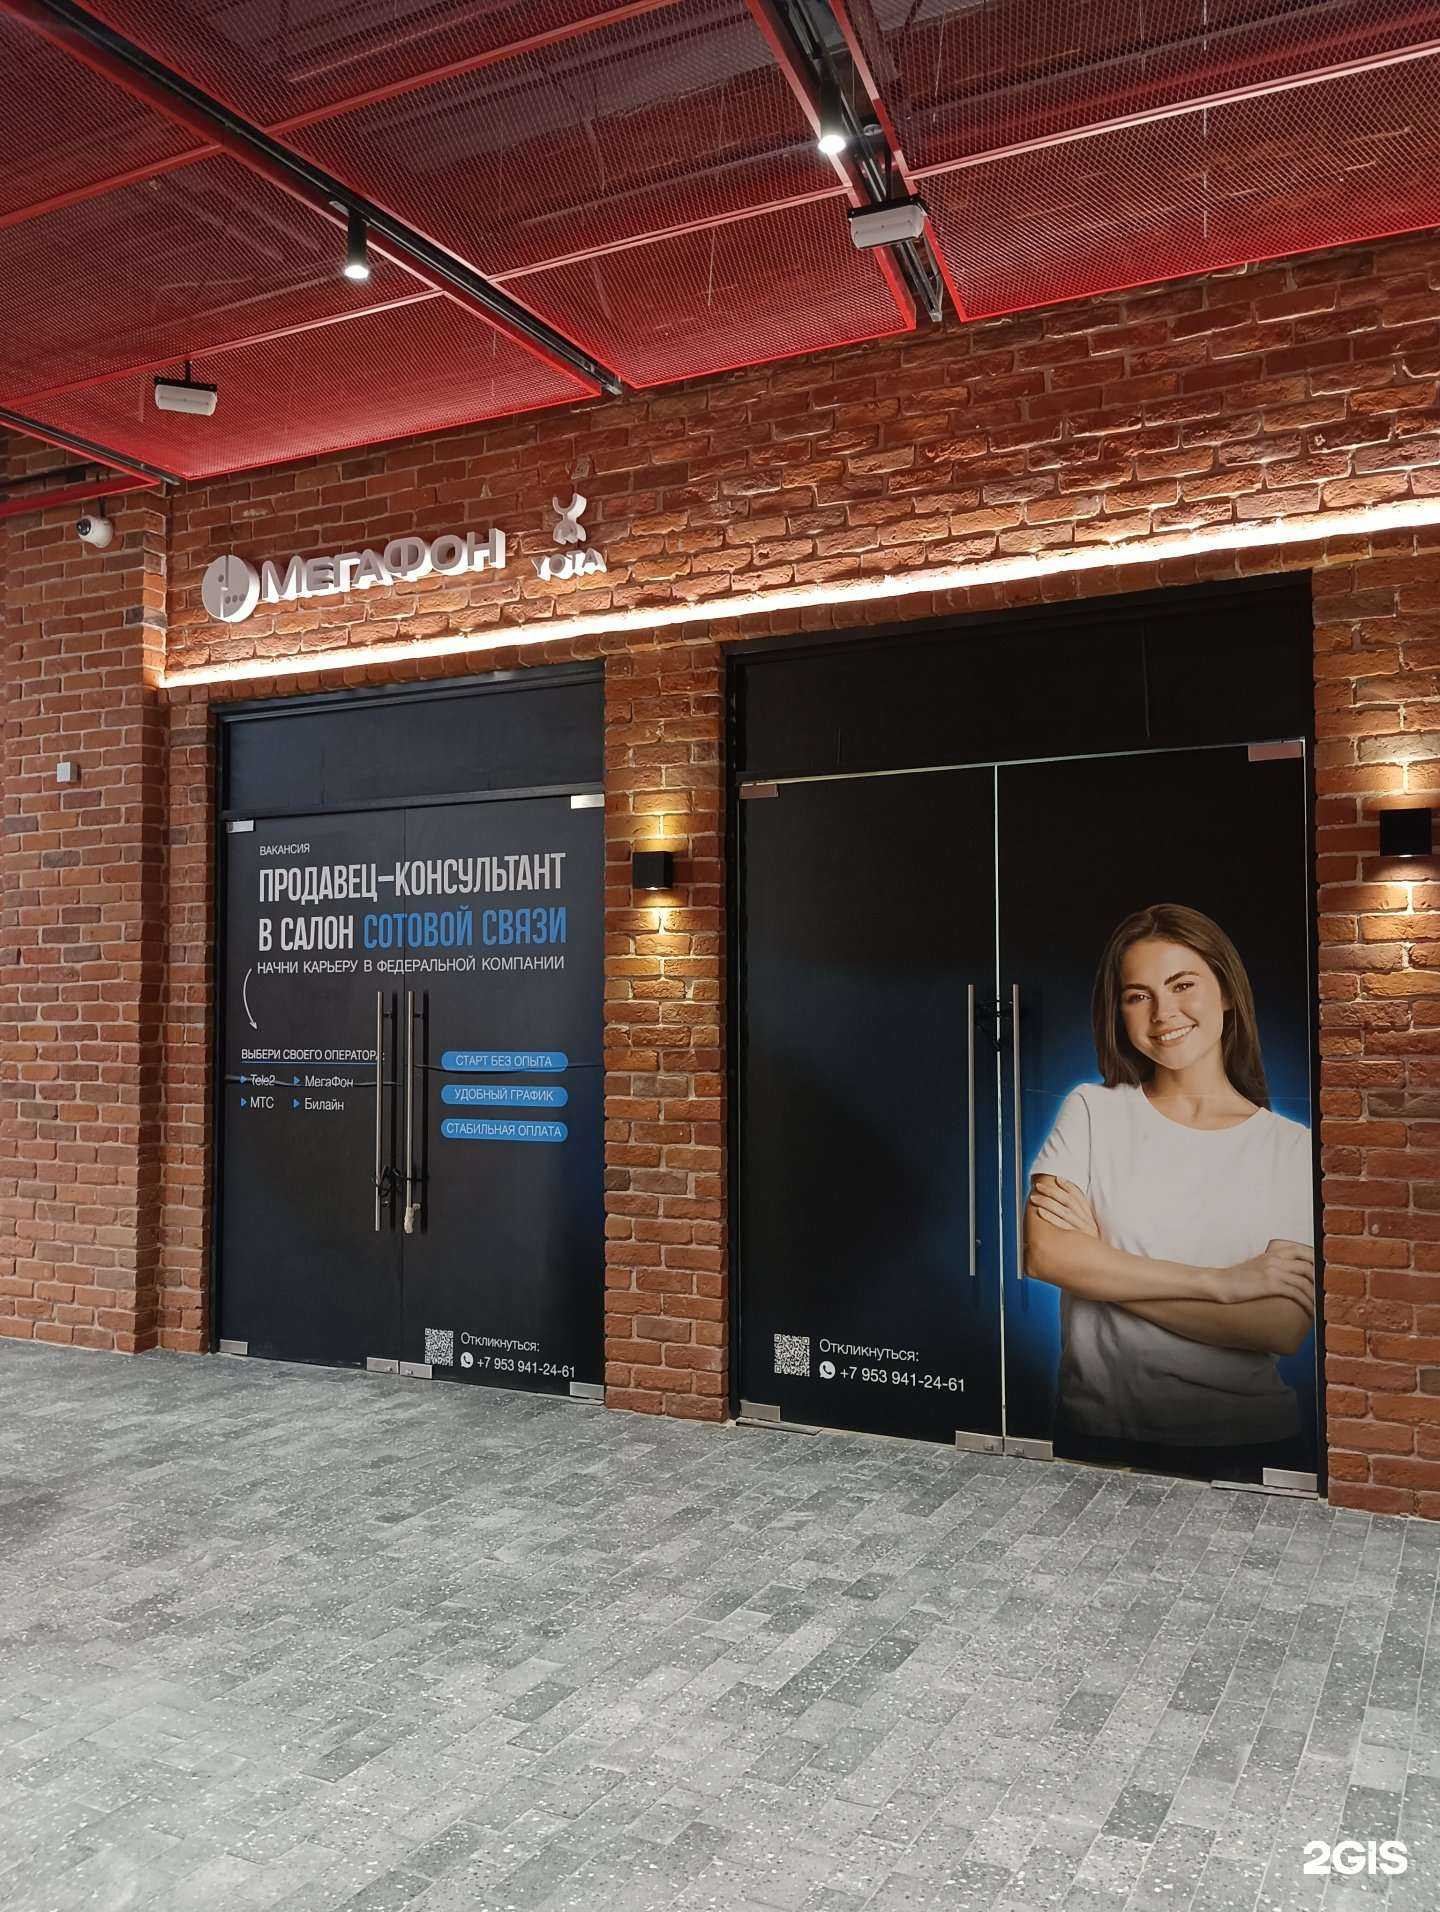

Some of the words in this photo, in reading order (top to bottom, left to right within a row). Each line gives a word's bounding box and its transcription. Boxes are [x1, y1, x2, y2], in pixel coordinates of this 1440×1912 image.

[261, 528, 506, 603] МЕГАФОН
[259, 843, 310, 857] ВАКАНСИЯ
[258, 917, 273, 952] В
[280, 915, 354, 951] САЛОН
[363, 904, 474, 950] СОТОВОЙ
[482, 906, 568, 946] СВЯЗИ
[257, 959, 299, 975] НАЧНИ
[303, 959, 359, 975] КАРЬЕРУ
[363, 958, 373, 973] В
[377, 954, 477, 975] ФЕДЕРАЛЬНОЙ
[481, 955, 566, 972] КОМПАНИИ
[241, 1048, 281, 1060] ВЫБЕРИ
[283, 1049, 323, 1060] СВОЕГО
[455, 1055, 488, 1066] СТАРТ
[491, 1055, 511, 1067] БЕЗ
[514, 1056, 553, 1067] ОПЫТА
[250, 1073, 276, 1087] Tele2
[304, 1074, 354, 1088] МегаФон
[454, 1087, 508, 1102] УДОБНЫЙ
[510, 1088, 554, 1102] ГРАФИК
[250, 1096, 275, 1109] МТС
[304, 1096, 345, 1111] Билайн
[446, 1122, 515, 1135] СТАБИЛЬНАЯ
[518, 1124, 562, 1137] ОПЛАТА
[460, 1331, 541, 1353] Откликнуться:
[819, 1338, 920, 1362] Откликнуться:
[476, 1357, 491, 1369] +7
[494, 1357, 515, 1372] 953
[517, 1360, 576, 1379] 941-24-61
[839, 1366, 858, 1380] +7
[861, 1367, 888, 1384] 953
[891, 1370, 966, 1393] 941-24-61
